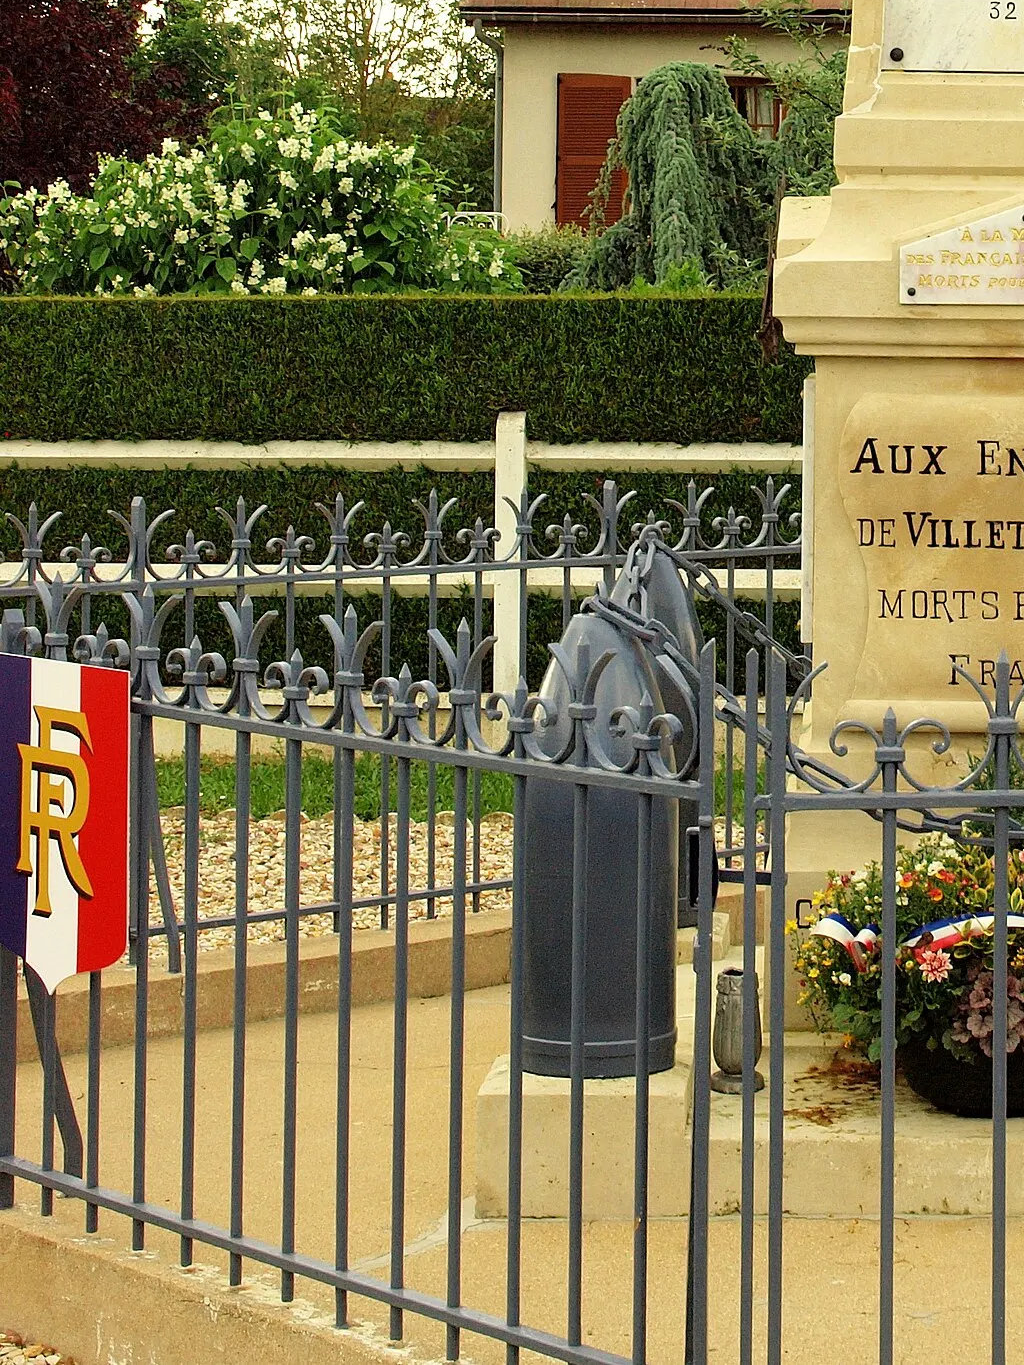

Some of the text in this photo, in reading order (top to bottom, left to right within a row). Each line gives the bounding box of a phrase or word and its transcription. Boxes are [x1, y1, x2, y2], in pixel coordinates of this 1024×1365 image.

[990, 2, 1016, 19] 32
[982, 231, 1003, 243] LA
[907, 255, 933, 265] DES
[918, 275, 979, 289] MORTS
[850, 438, 947, 475] AUX
[856, 519, 896, 548] DE
[878, 589, 998, 623] MORTS
